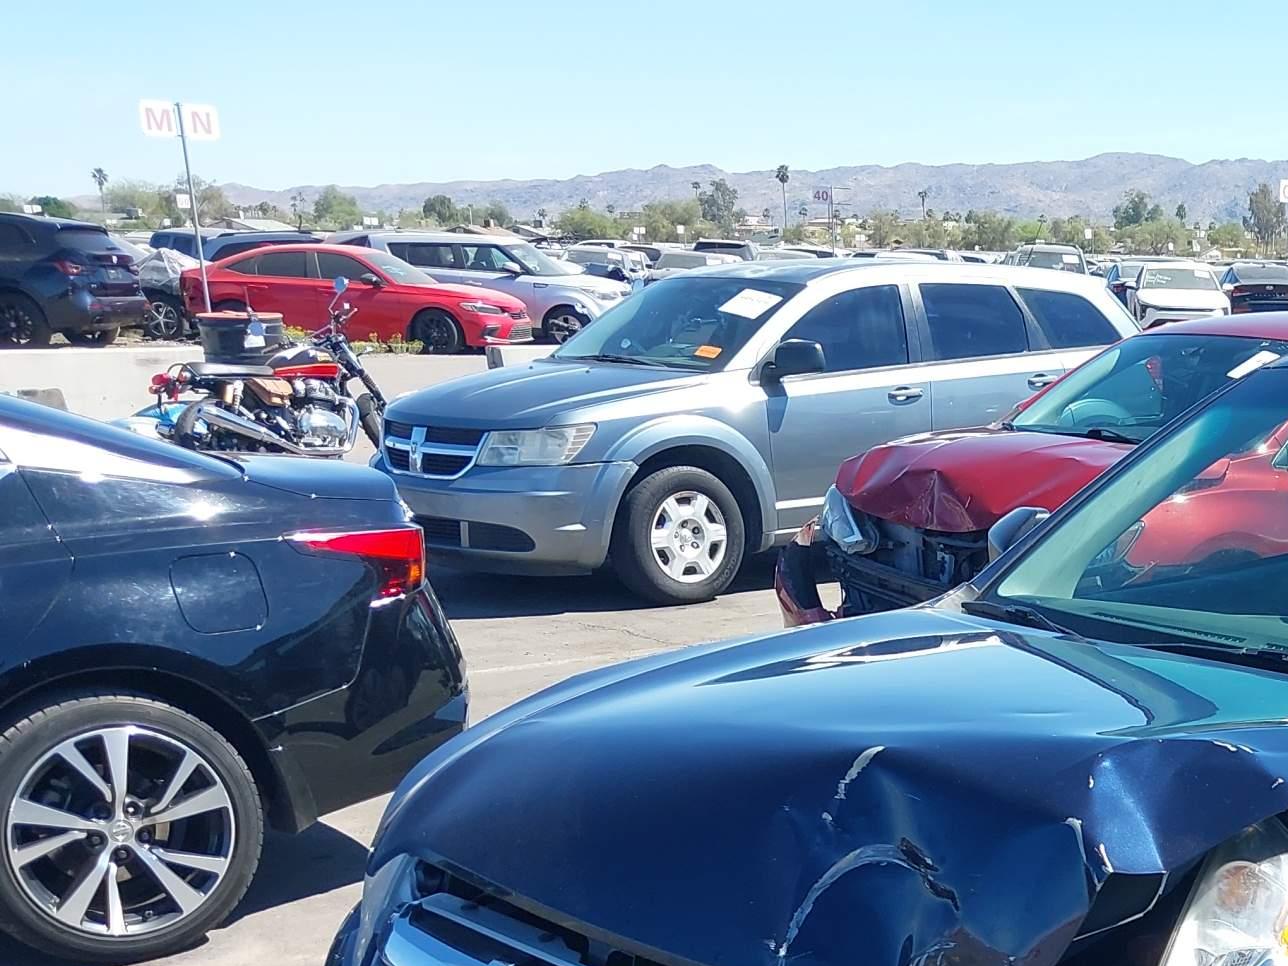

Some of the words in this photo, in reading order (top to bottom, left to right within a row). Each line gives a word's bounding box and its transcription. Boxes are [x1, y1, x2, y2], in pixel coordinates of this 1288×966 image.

[144, 107, 172, 132] M
[191, 111, 213, 135] N
[813, 190, 829, 202] 40
